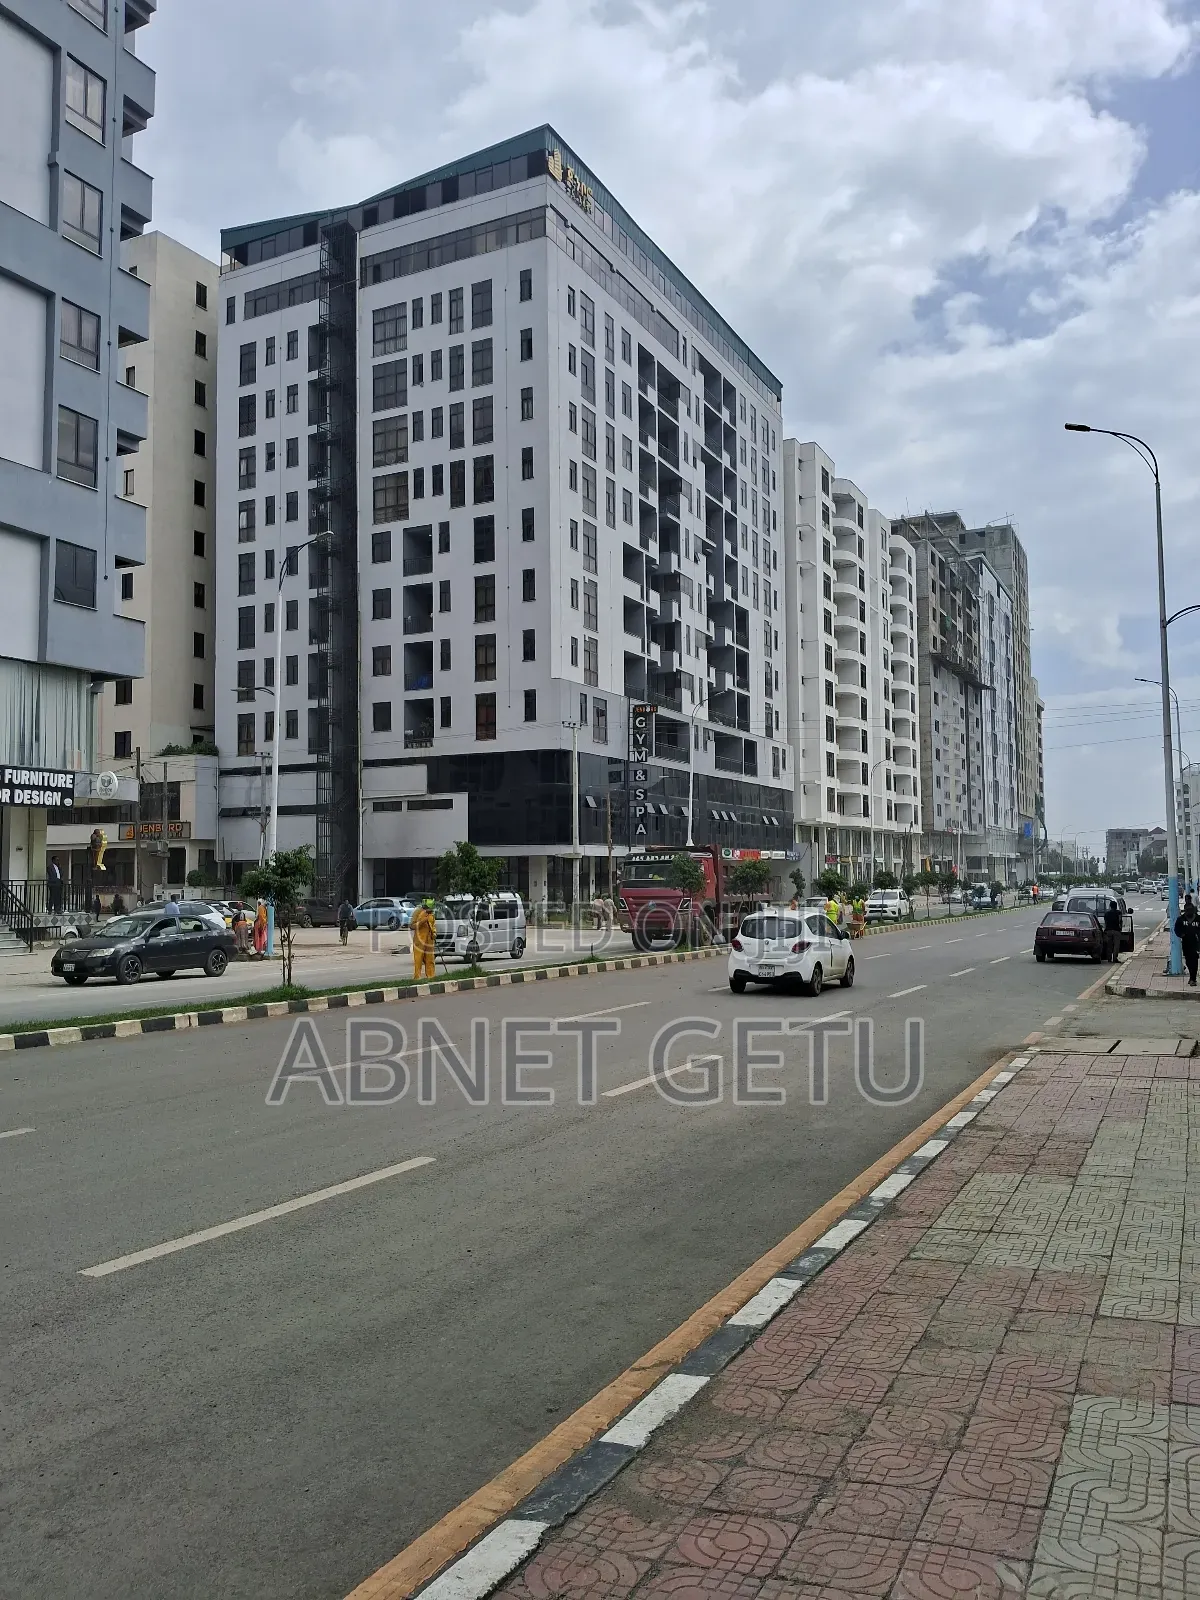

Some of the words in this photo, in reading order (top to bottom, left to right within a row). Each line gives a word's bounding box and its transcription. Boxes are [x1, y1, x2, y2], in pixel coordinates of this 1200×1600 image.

[4, 769, 74, 789] FURNITURE
[0, 788, 11, 803] R
[14, 788, 62, 806] DESIGN
[139, 823, 183, 836] JENBRD
